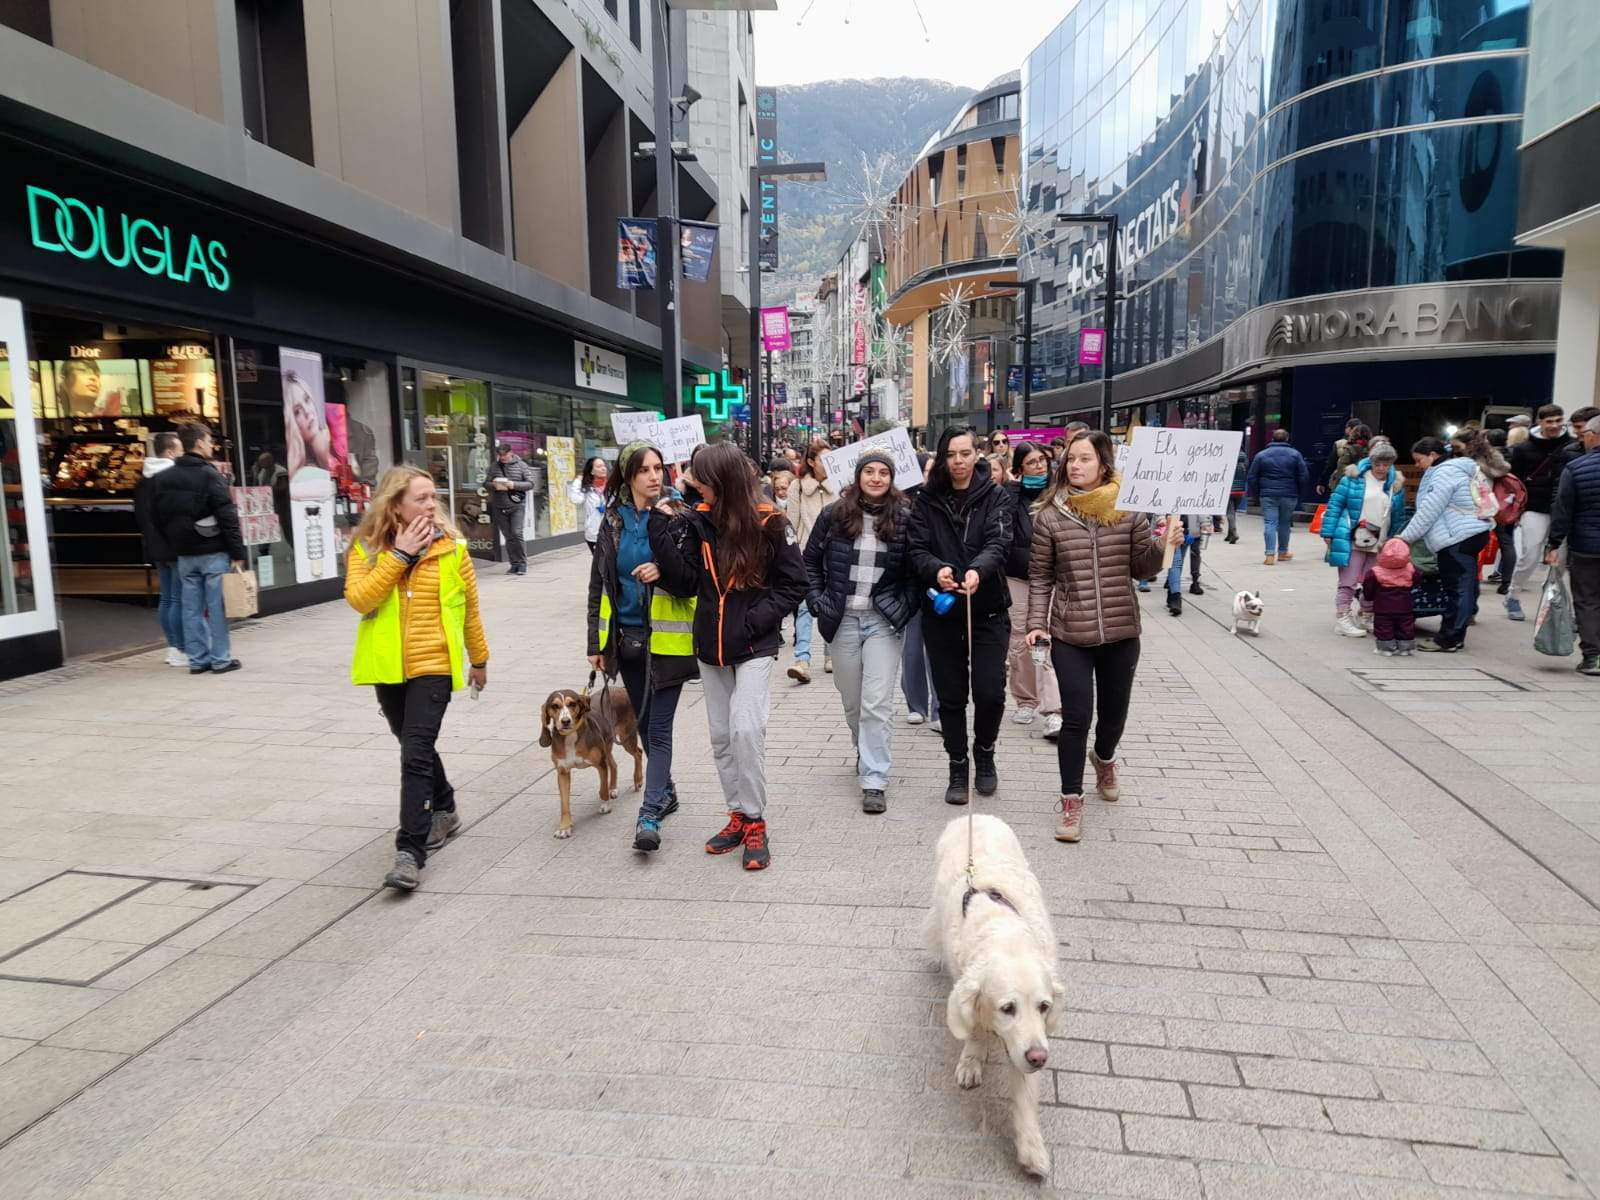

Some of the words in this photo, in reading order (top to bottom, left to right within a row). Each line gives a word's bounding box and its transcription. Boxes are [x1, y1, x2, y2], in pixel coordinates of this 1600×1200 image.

[26, 184, 230, 291] DOUGLAS
[70, 346, 100, 357] Dior
[1154, 430, 1177, 456] Els
[1187, 443, 1224, 465] gossos
[825, 455, 841, 475] Per
[1132, 457, 1174, 482] també
[1204, 463, 1228, 488] part
[1122, 486, 1139, 505] de
[1149, 487, 1163, 508] la
